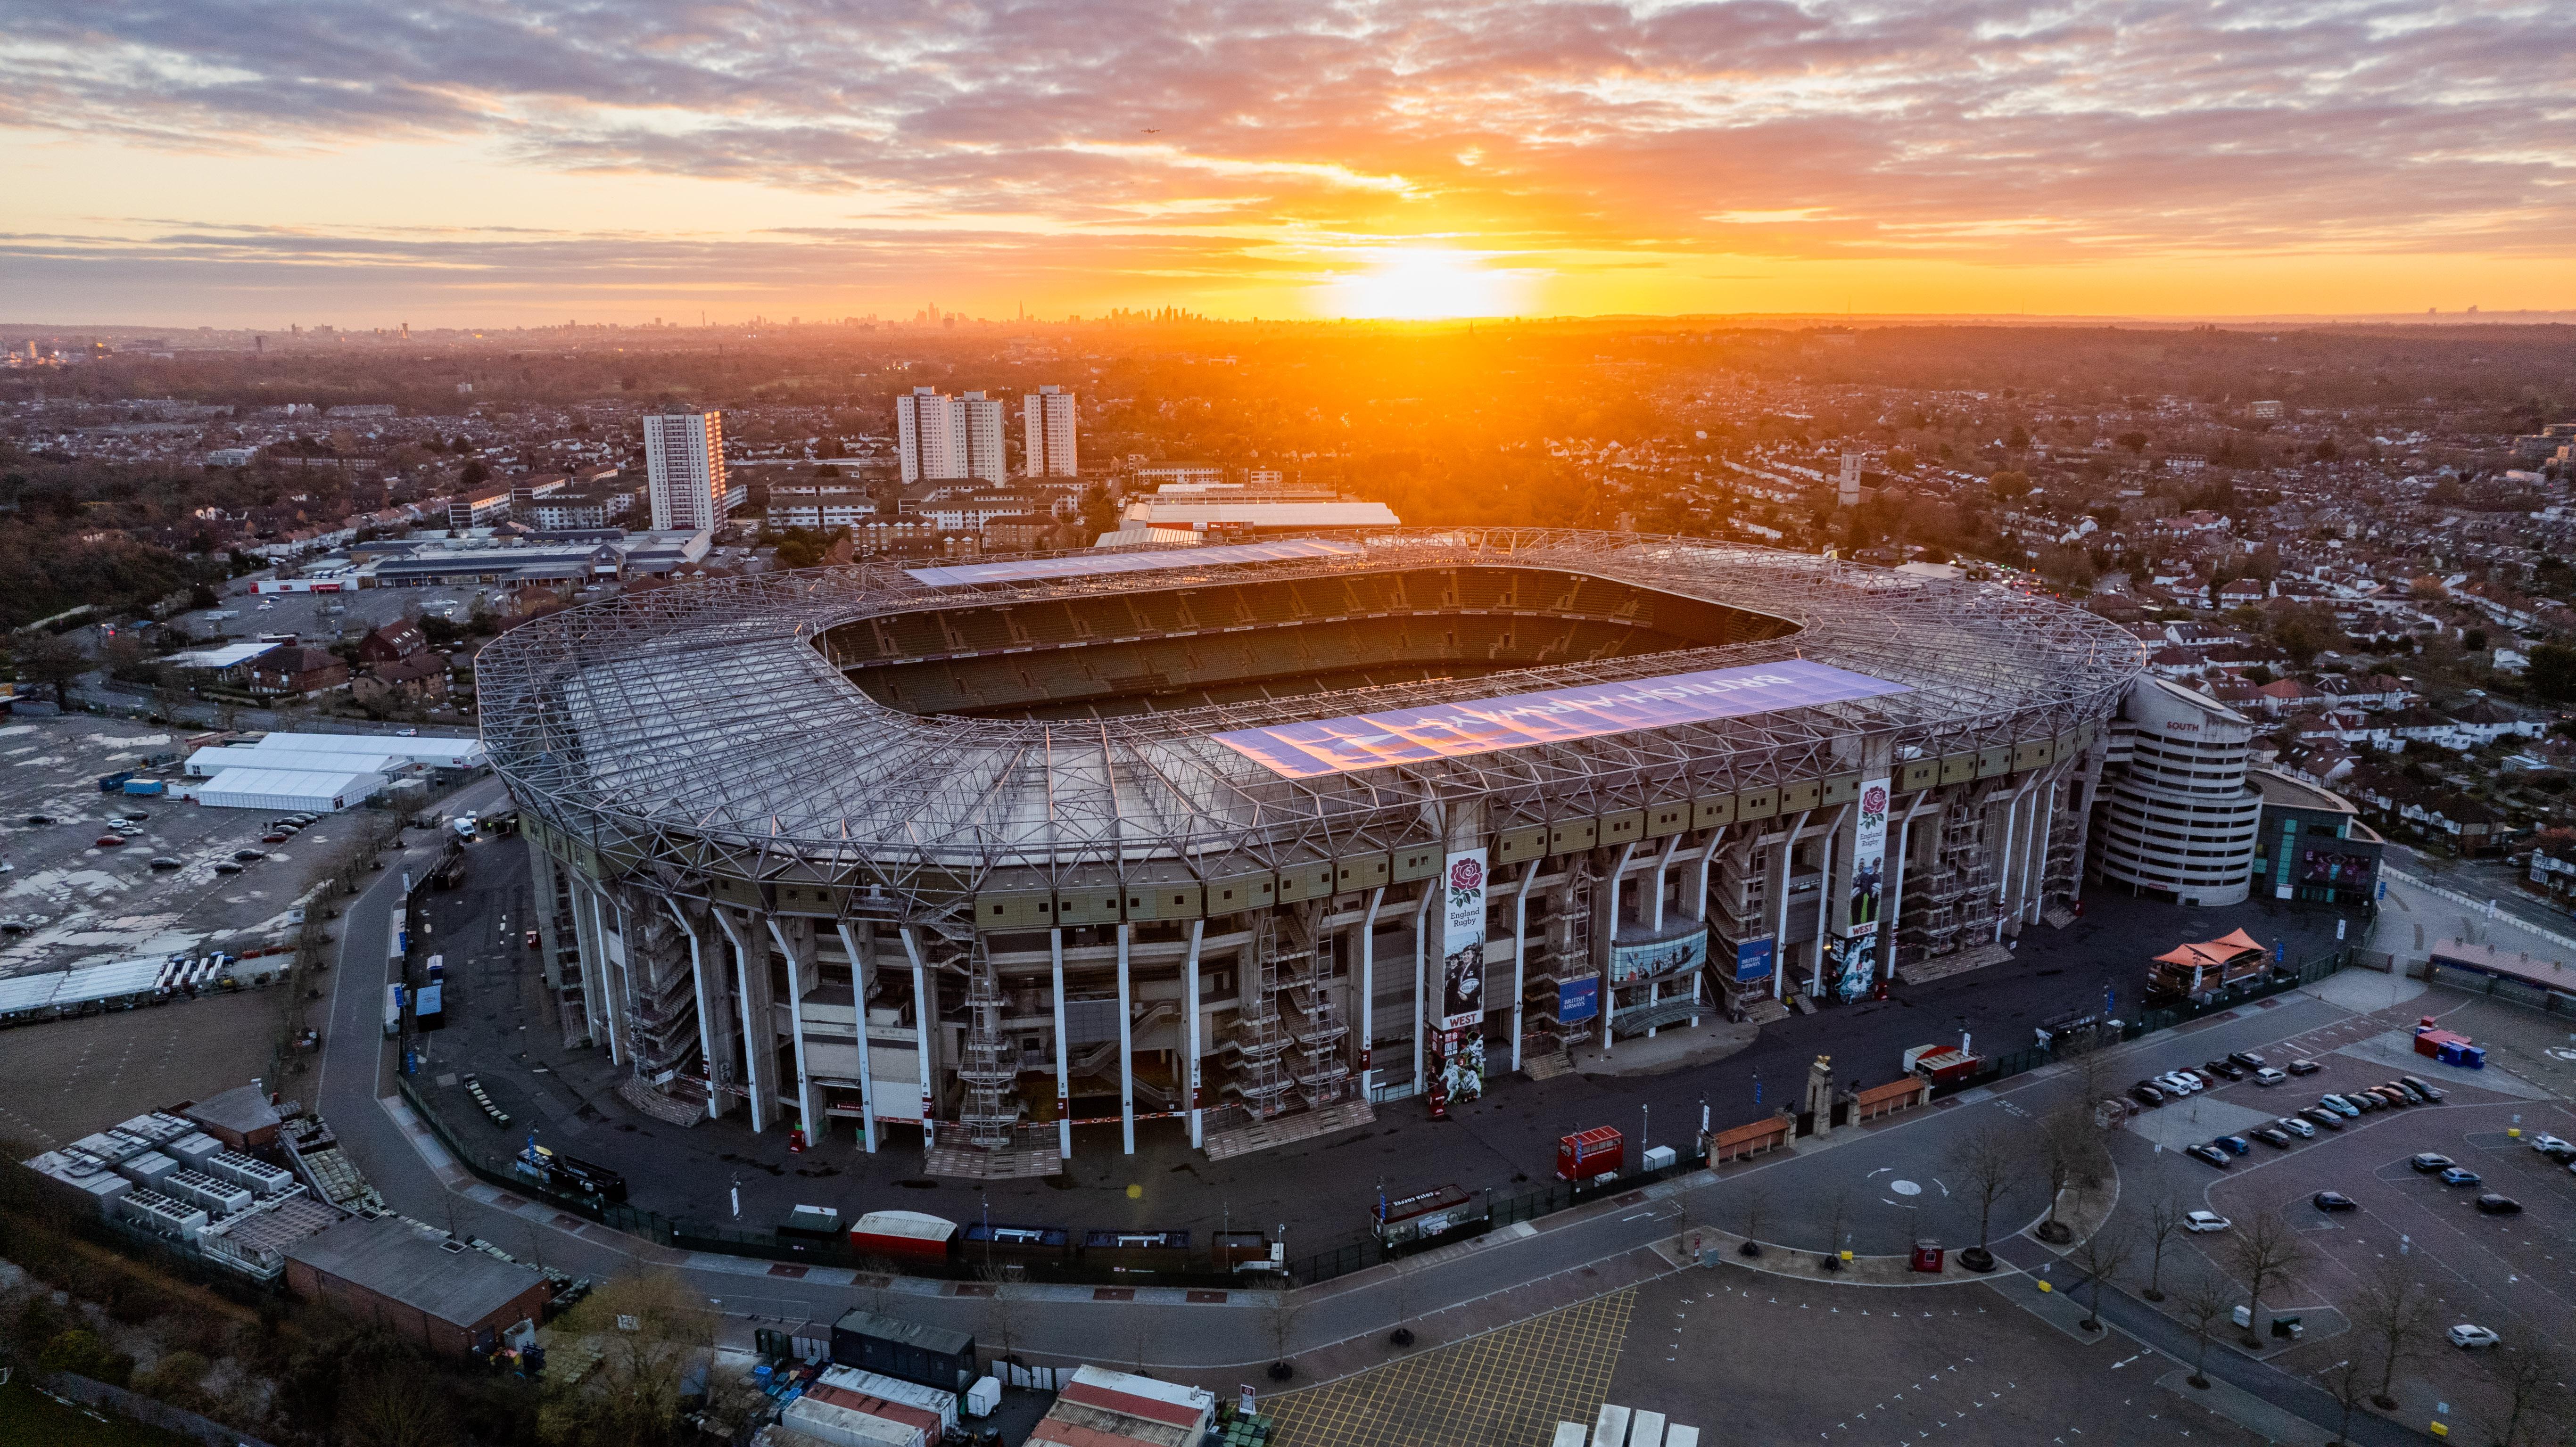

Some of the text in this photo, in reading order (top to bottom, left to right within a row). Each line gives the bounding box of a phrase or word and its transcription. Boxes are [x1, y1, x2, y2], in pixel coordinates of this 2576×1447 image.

[1416, 674, 1795, 730] BRITISH AIRWAYS
[2167, 721, 2199, 732] SOUTH
[1860, 830, 1882, 840] England
[1862, 839, 1879, 847] Rugby
[1450, 907, 1479, 919] England
[1453, 917, 1476, 927] Rugby
[1852, 924, 1873, 935] WEST
[1742, 956, 1760, 964] BRITISH
[1741, 962, 1760, 970] AIRWAYS
[1564, 995, 1585, 1005] BRITISH
[1563, 1001, 1585, 1010] AIRWAYS
[1450, 1013, 1477, 1027] WEST
[1393, 1192, 1434, 1206] COSTA COFFEE
